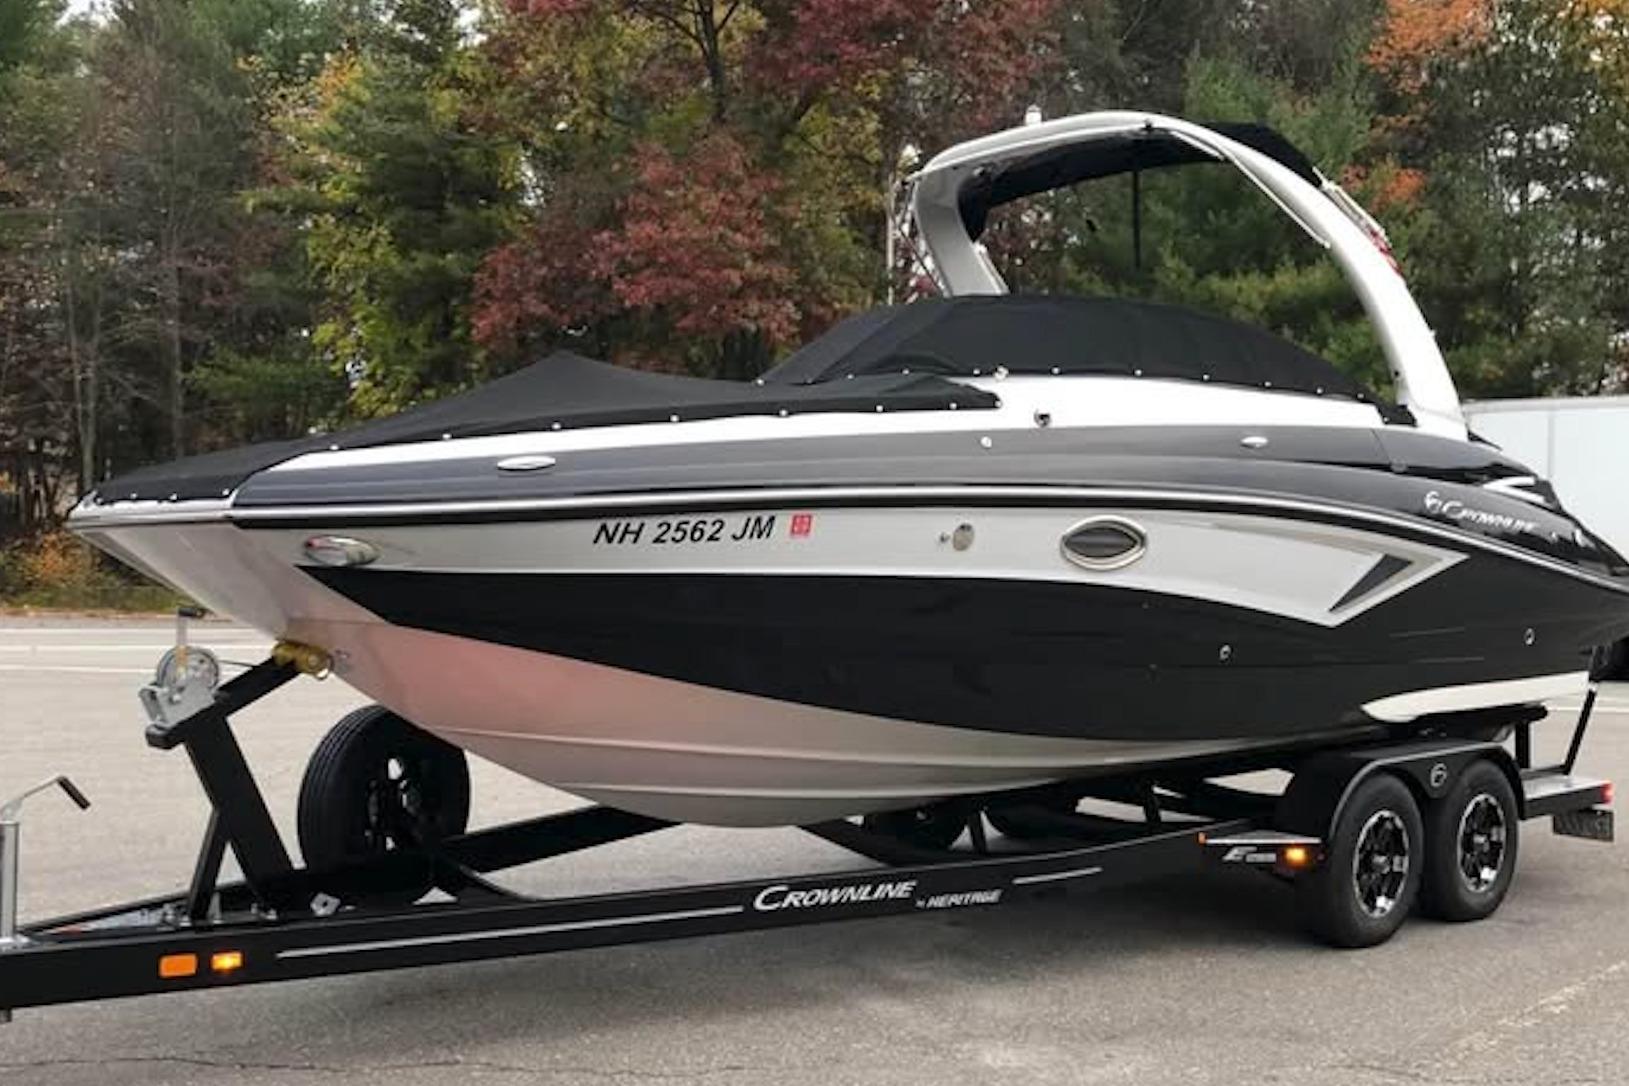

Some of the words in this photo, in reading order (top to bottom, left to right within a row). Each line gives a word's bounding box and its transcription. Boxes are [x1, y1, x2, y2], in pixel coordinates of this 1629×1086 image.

[592, 522, 646, 544] NH
[652, 519, 726, 544] 2562
[731, 515, 776, 541] JM
[753, 880, 918, 912] CROWNLINE
